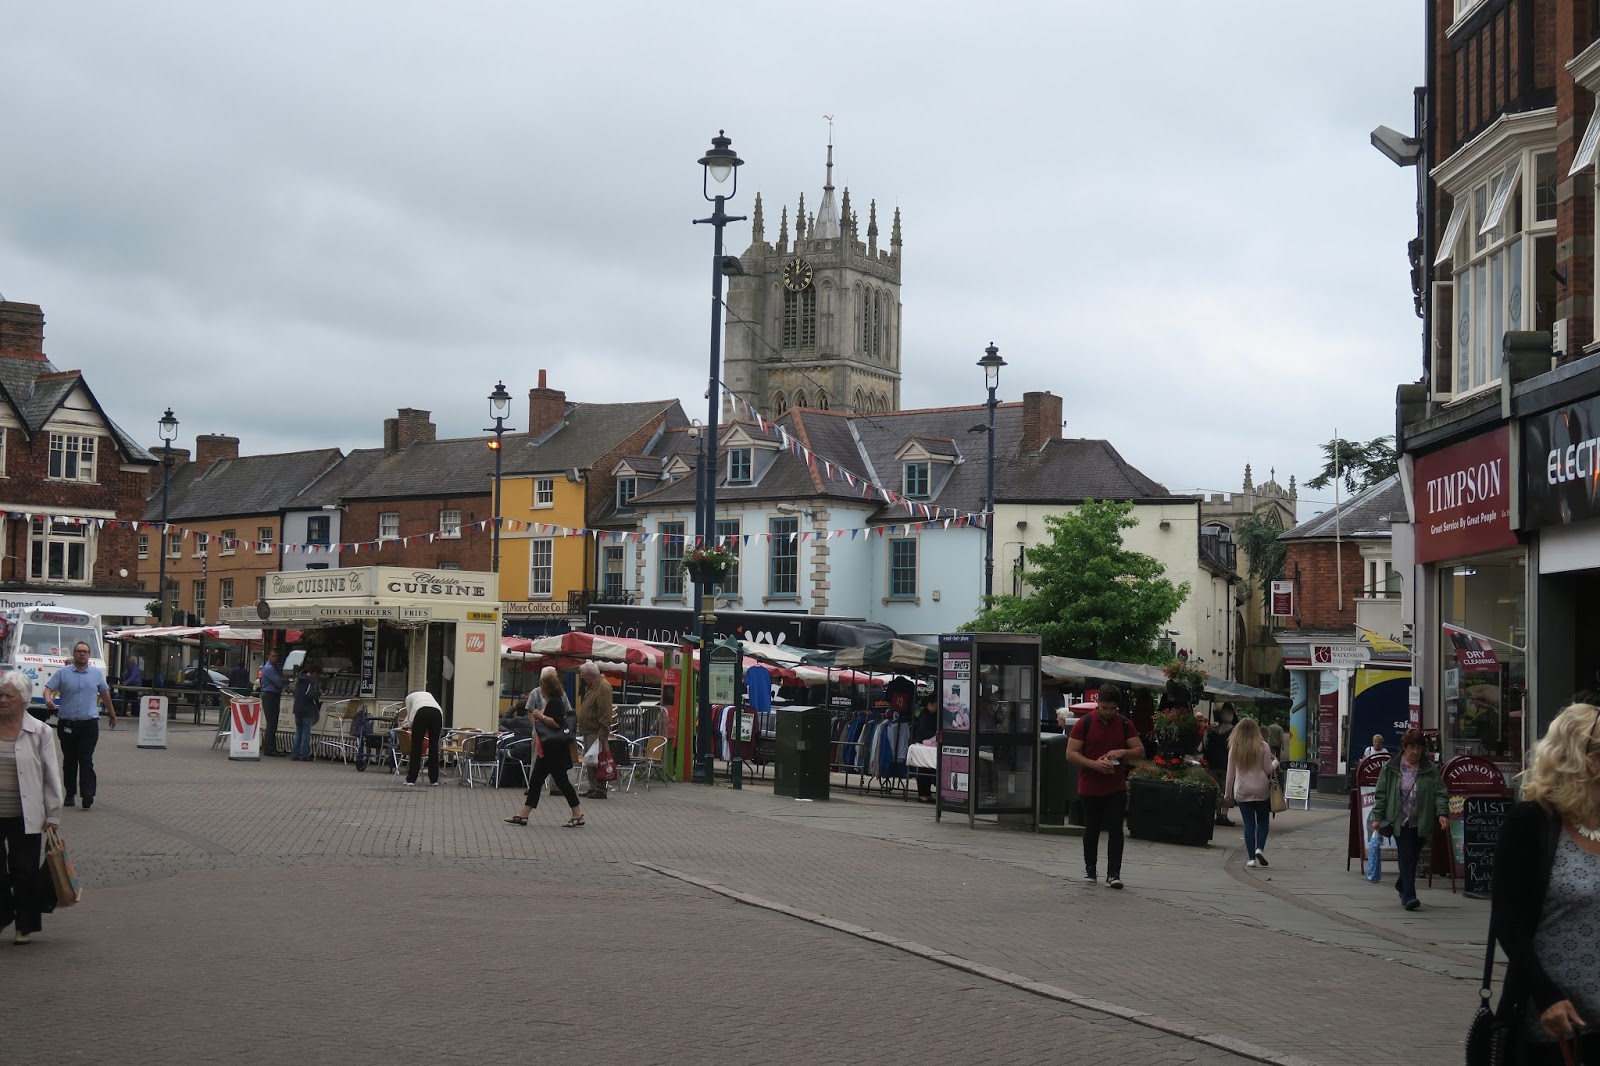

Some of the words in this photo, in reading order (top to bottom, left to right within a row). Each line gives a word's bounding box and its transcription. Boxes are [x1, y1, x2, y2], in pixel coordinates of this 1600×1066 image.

[1427, 458, 1501, 514] TIMPSON
[1430, 522, 1443, 535] Great
[1443, 519, 1459, 533] Service
[1459, 517, 1466, 530] By
[1467, 513, 1480, 527] Great
[1480, 510, 1497, 525] People
[272, 575, 295, 594] Classic
[297, 578, 346, 594] CUISINE
[412, 572, 460, 585] Classic
[387, 582, 485, 597] CUISINE
[0, 599, 33, 609] Thomas
[510, 602, 527, 612] More
[528, 602, 550, 612] Coffee
[42, 613, 79, 624] Miguels
[467, 636, 484, 651] illy
[1466, 651, 1485, 659] DRY
[1463, 658, 1495, 666] CLEANING
[1363, 761, 1387, 774] TIMP
[1448, 764, 1495, 780] TIMPSON
[1468, 800, 1511, 814] MIST
